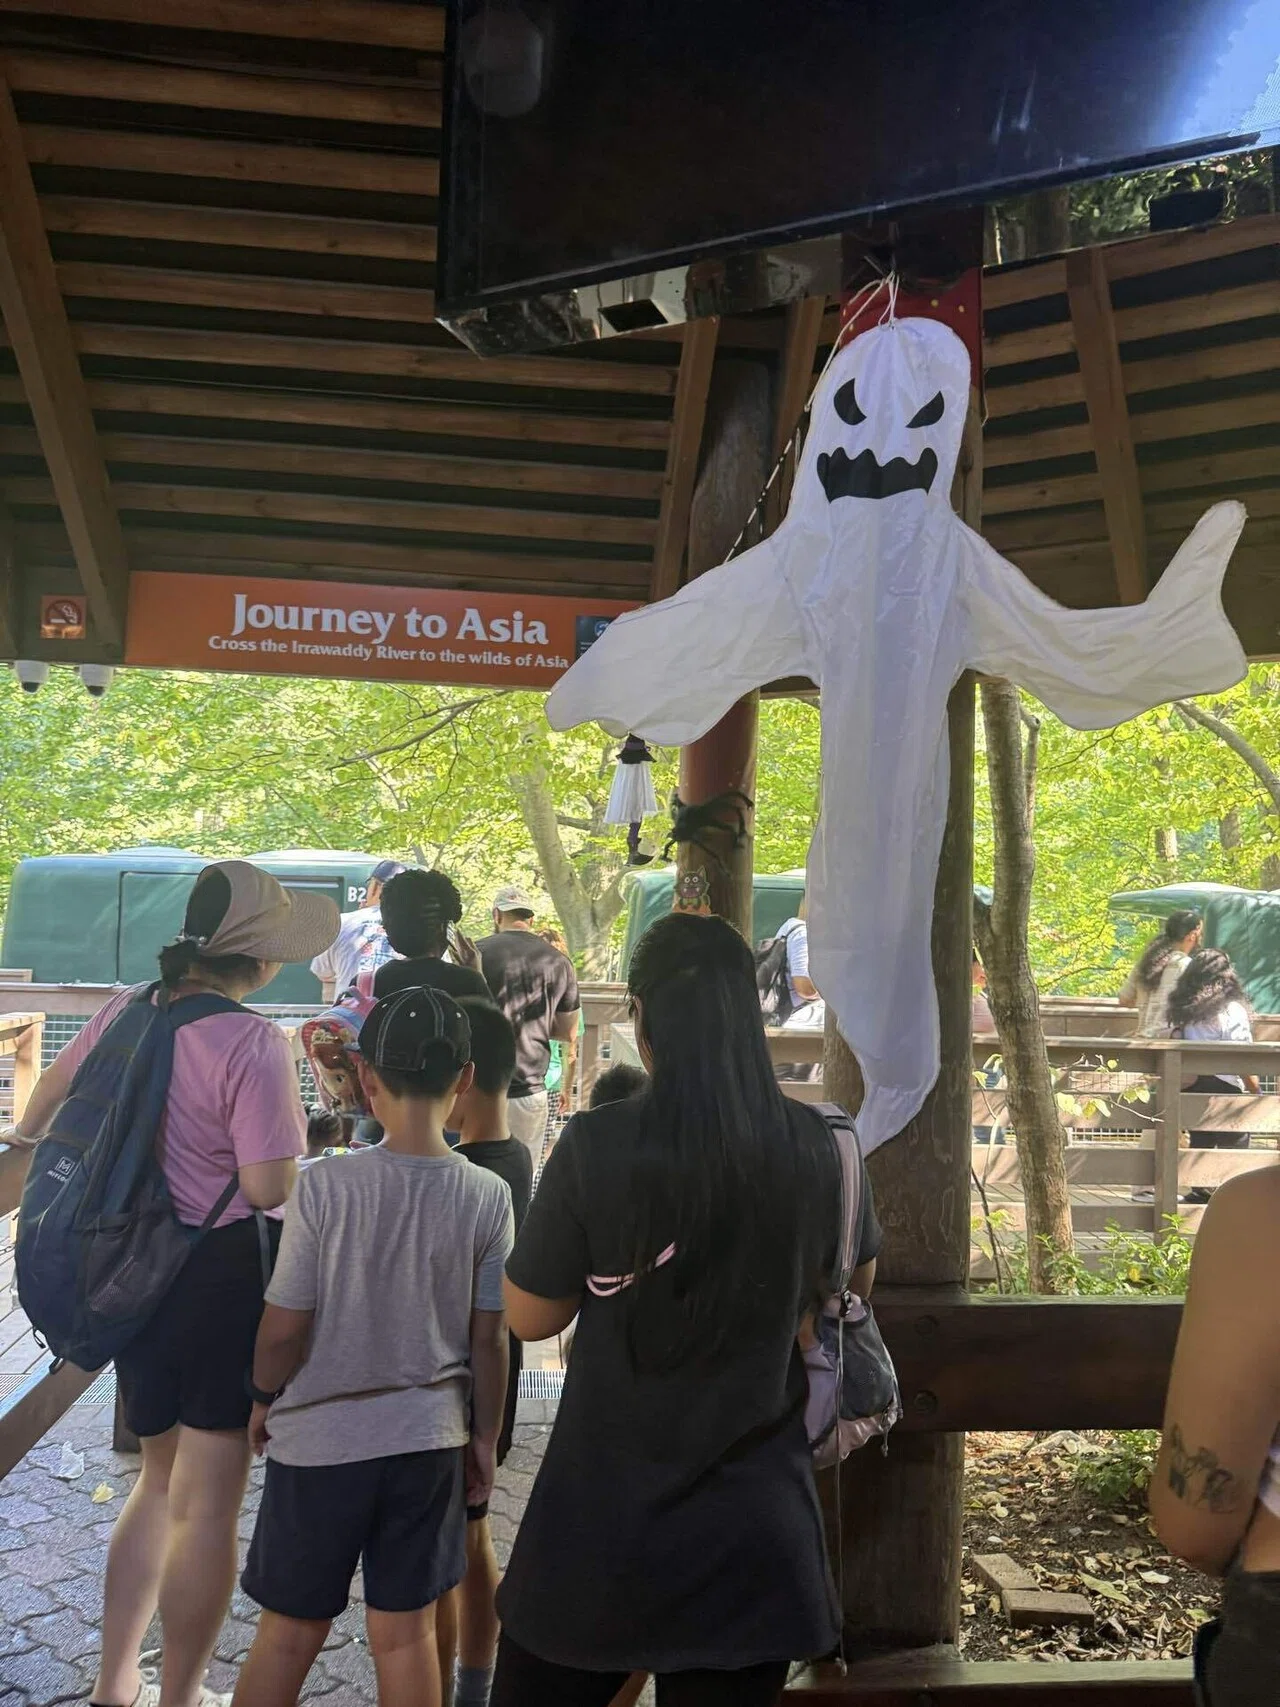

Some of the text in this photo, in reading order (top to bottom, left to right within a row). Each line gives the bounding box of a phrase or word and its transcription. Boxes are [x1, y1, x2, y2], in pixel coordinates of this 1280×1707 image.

[231, 593, 549, 645] Journey to Asia
[208, 635, 569, 669] Cross the Irrawaddy River to the wilds of Asia
